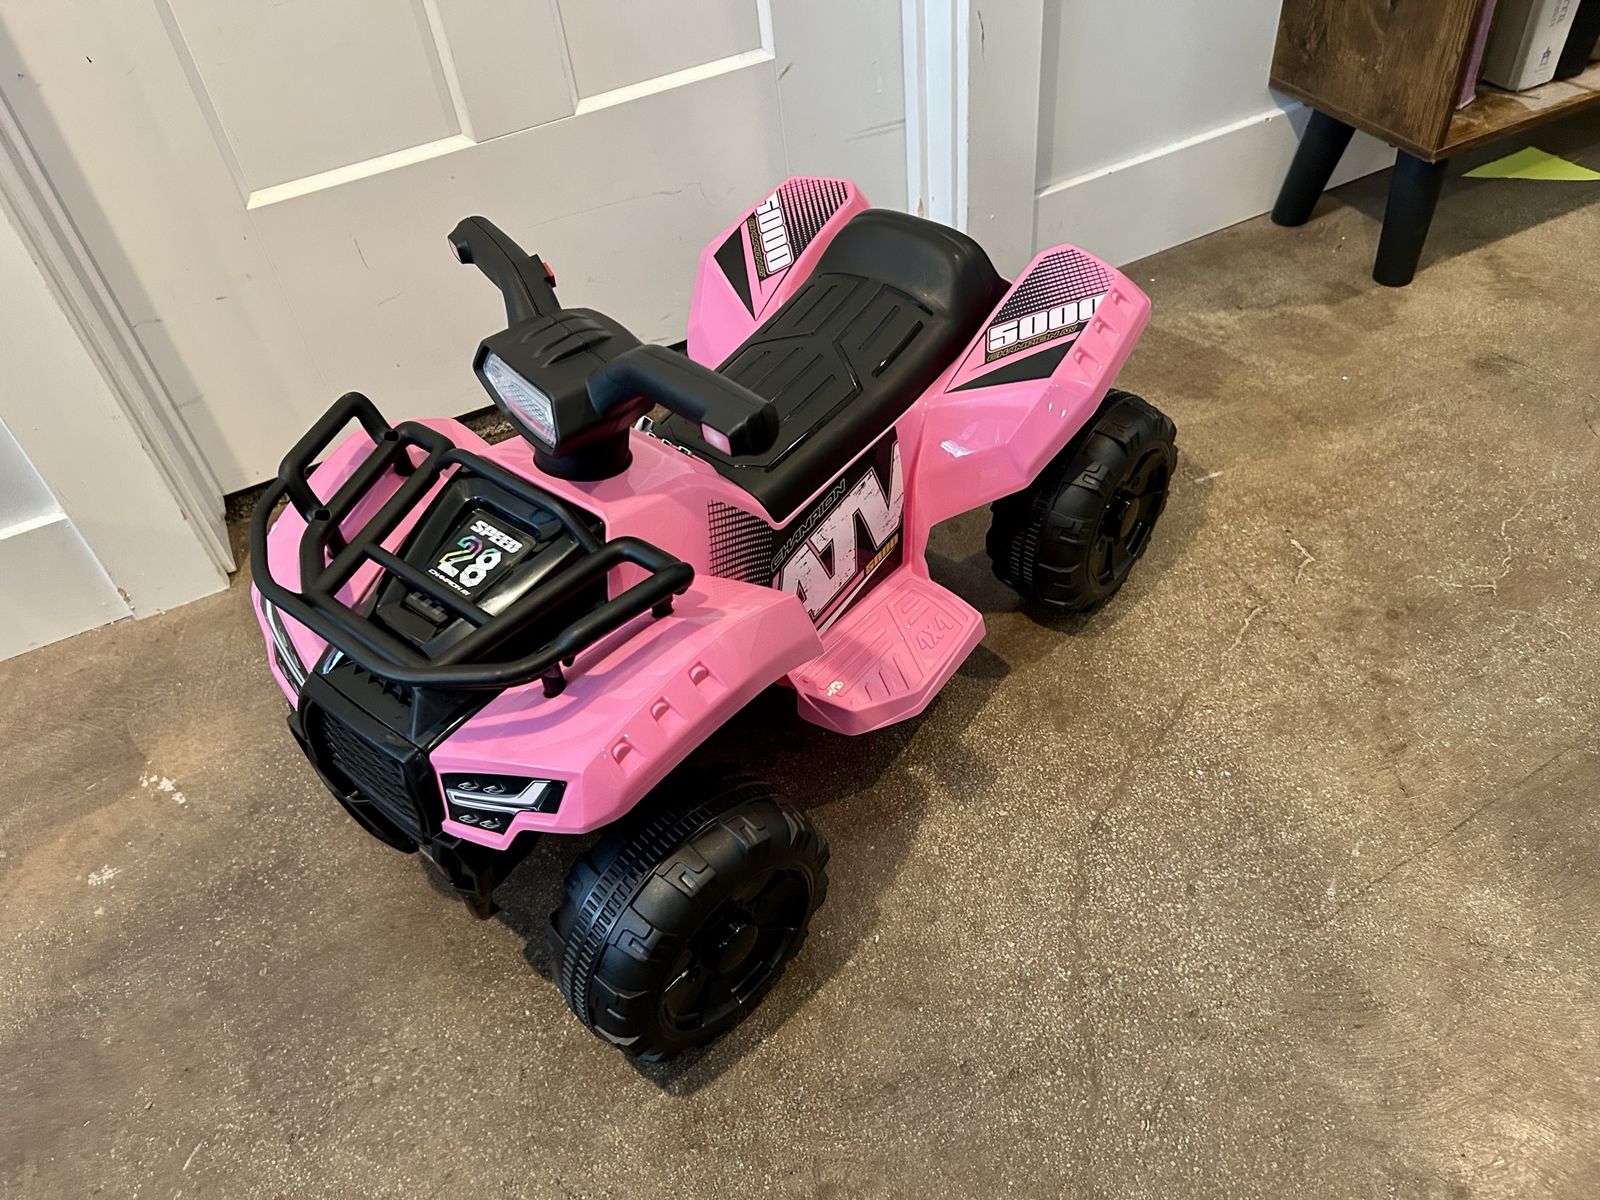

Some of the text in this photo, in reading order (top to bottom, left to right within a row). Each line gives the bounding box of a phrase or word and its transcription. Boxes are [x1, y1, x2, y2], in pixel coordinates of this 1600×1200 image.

[755, 191, 795, 275] 5000
[987, 293, 1106, 353] 5000
[470, 520, 523, 554] SPEED
[771, 478, 846, 572] CHAMPION
[777, 440, 905, 620] ATV
[437, 535, 502, 588] 28
